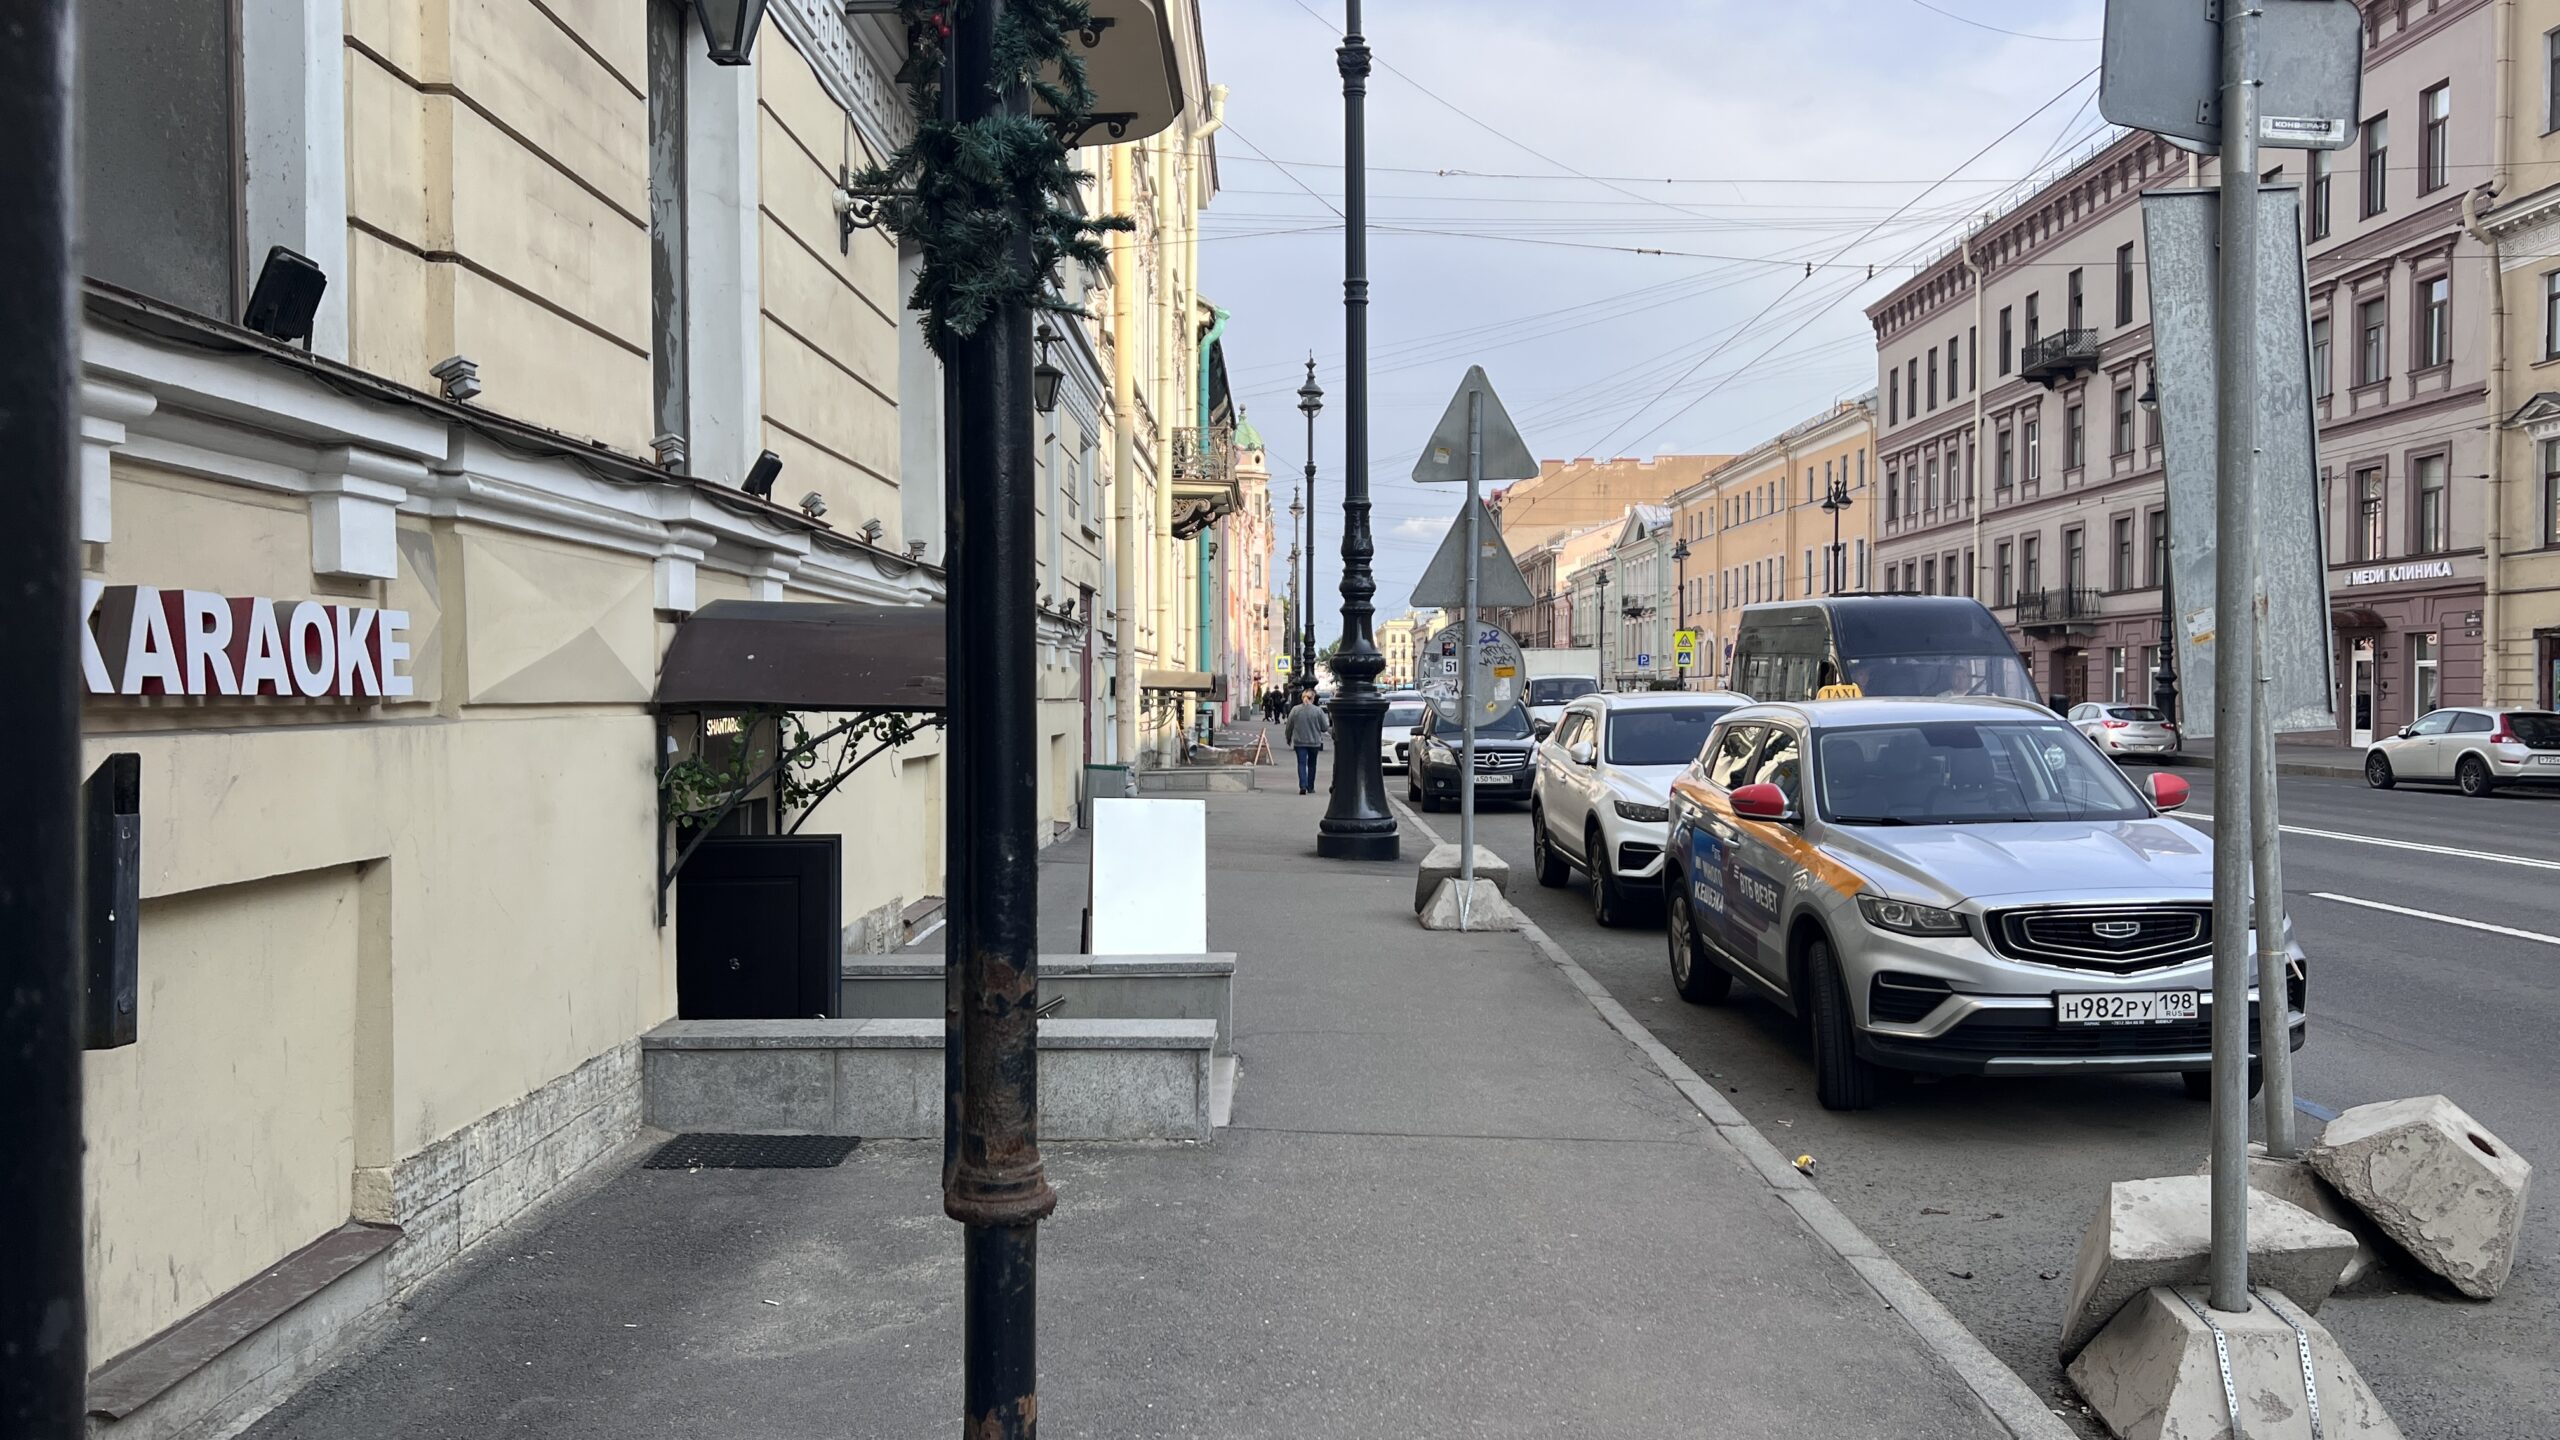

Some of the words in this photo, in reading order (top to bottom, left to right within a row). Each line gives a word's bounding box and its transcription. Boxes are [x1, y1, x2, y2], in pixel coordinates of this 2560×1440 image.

[2388, 561, 2453, 582] КЛИНИКА
[80, 578, 414, 698] KARAOKE
[1445, 661, 1457, 673] 51
[1825, 688, 1856, 699] TAXI
[1740, 872, 1754, 900] ВТБ
[1754, 883, 1778, 915] ВЕЗЁТ
[2066, 996, 2153, 1019] Н982РУ
[2159, 993, 2192, 1010] 198
